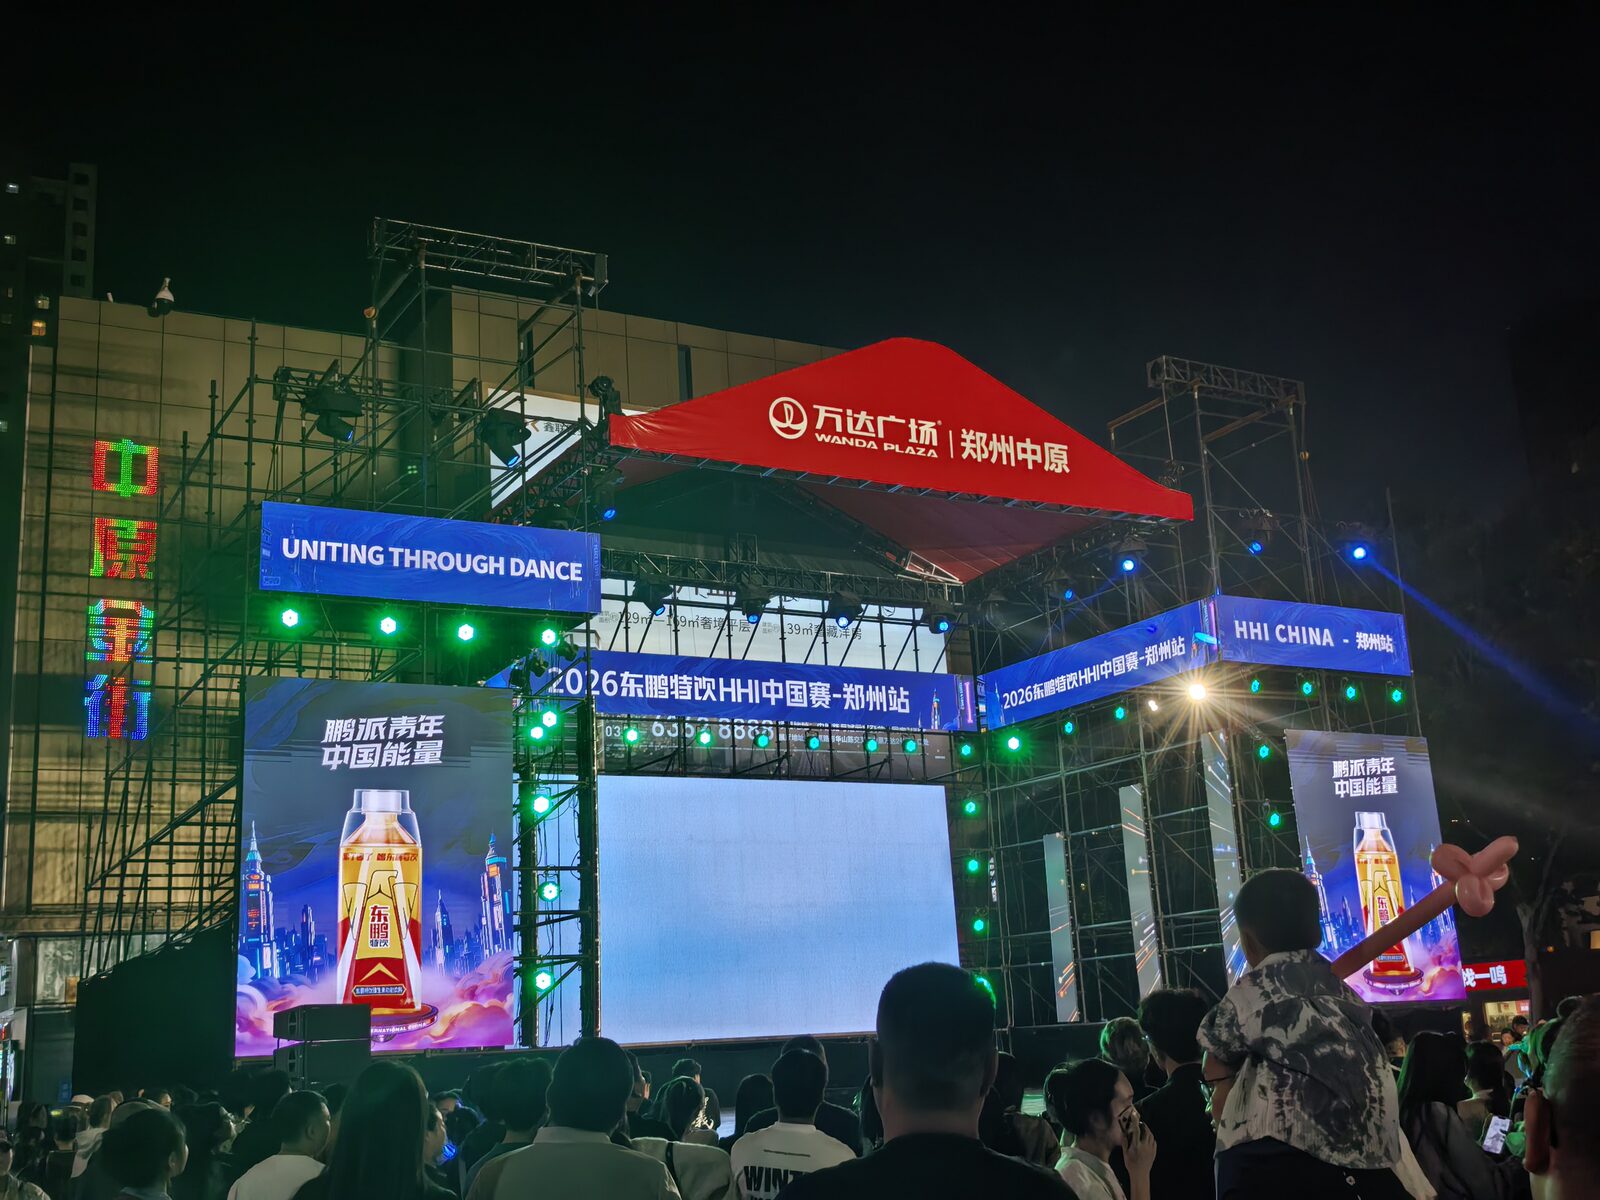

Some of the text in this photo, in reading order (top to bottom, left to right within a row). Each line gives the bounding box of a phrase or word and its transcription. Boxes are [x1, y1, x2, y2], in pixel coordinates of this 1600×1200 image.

[812, 404, 1070, 473] 万达广场 郑州中原
[815, 432, 938, 458] WANDA PLAZA
[282, 537, 384, 566] UNITING
[388, 546, 505, 576] THROUGH
[510, 557, 583, 581] DANCE
[84, 438, 159, 741] 中原金街
[1234, 620, 1269, 641] HHI
[1275, 624, 1334, 647] CHINA
[1356, 631, 1394, 653] 郑州站
[1002, 635, 1186, 710] 2026东鹏特饮HHI中国赛-郑州站
[548, 667, 910, 714] 2026东鹏特饮HHI中国赛-郑州站
[320, 714, 446, 743] 鹏派青年
[320, 740, 443, 771] 中国能量
[1332, 757, 1395, 779] 鹏派青年
[1334, 775, 1399, 798] 中国能量
